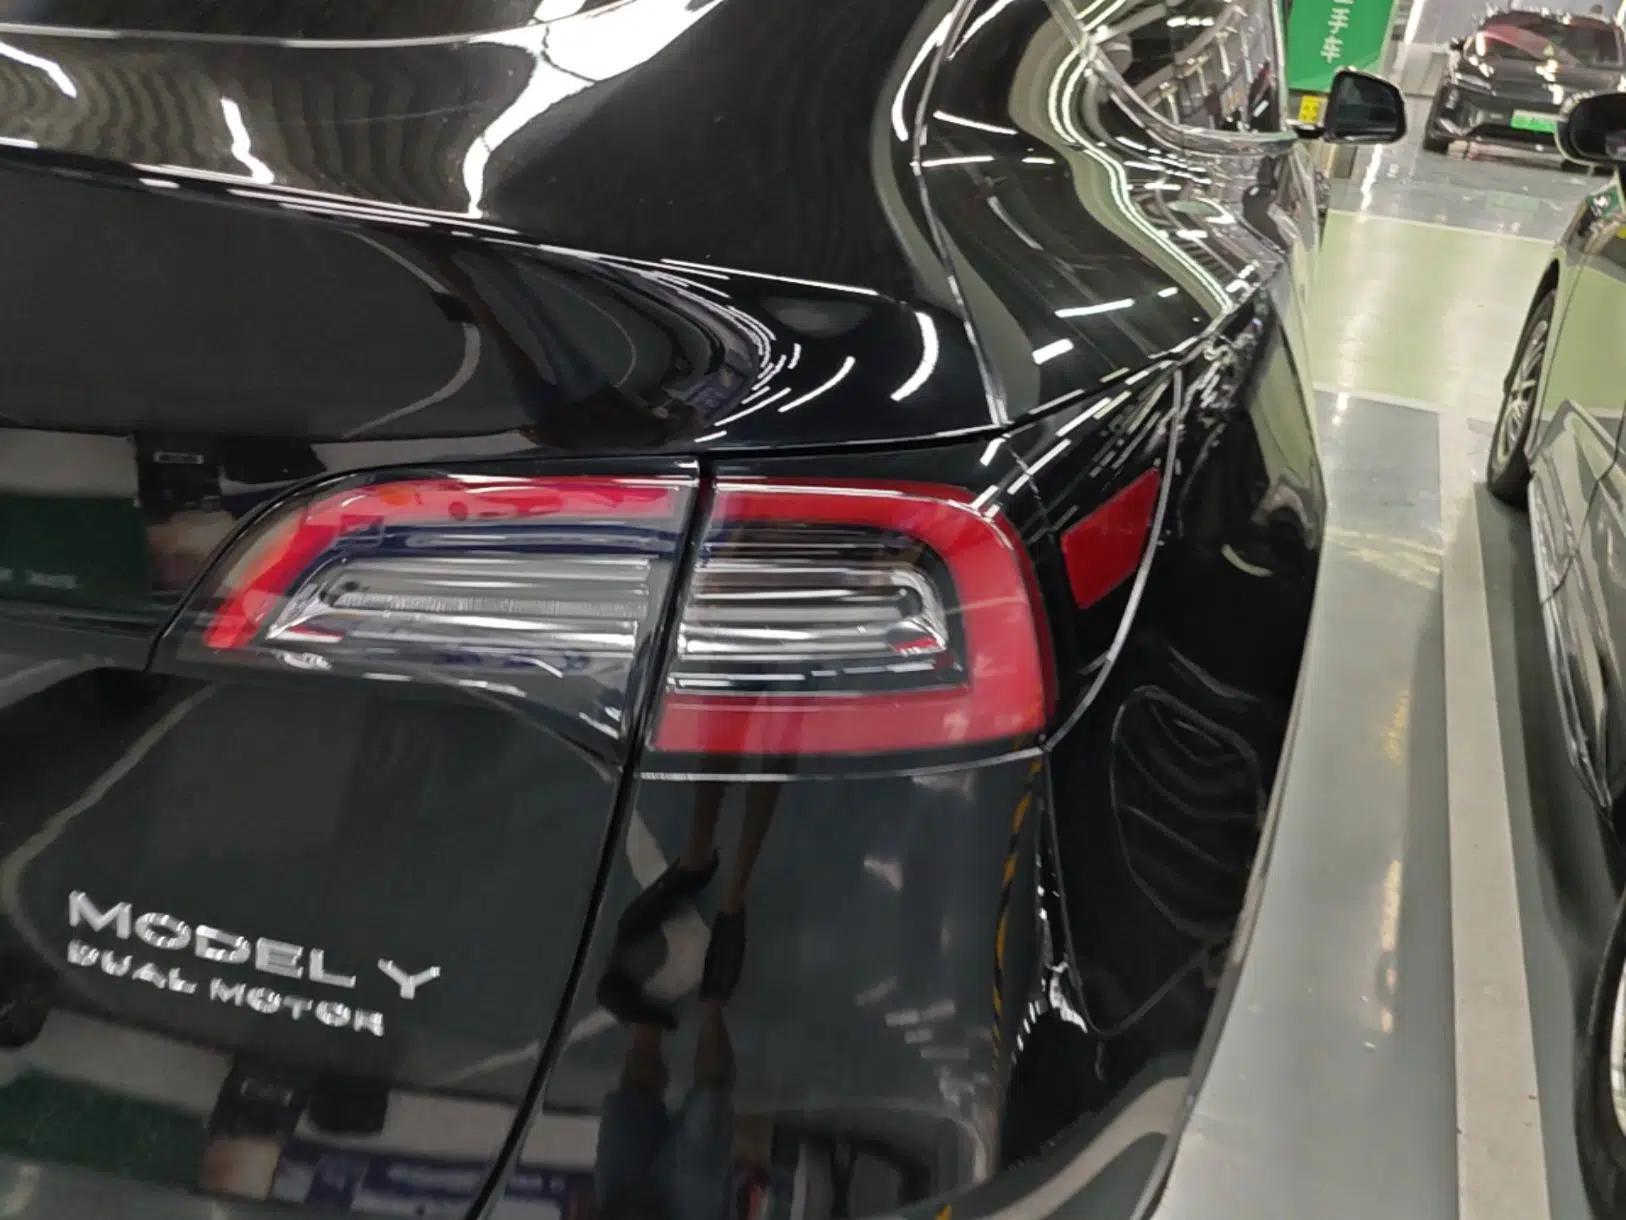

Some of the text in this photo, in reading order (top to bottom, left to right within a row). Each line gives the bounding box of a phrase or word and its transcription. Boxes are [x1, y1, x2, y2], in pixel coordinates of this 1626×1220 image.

[1320, 0, 1354, 64] 手车
[67, 937, 386, 1037] DUAL MOTOR
[68, 889, 441, 1000] MODEL Y
